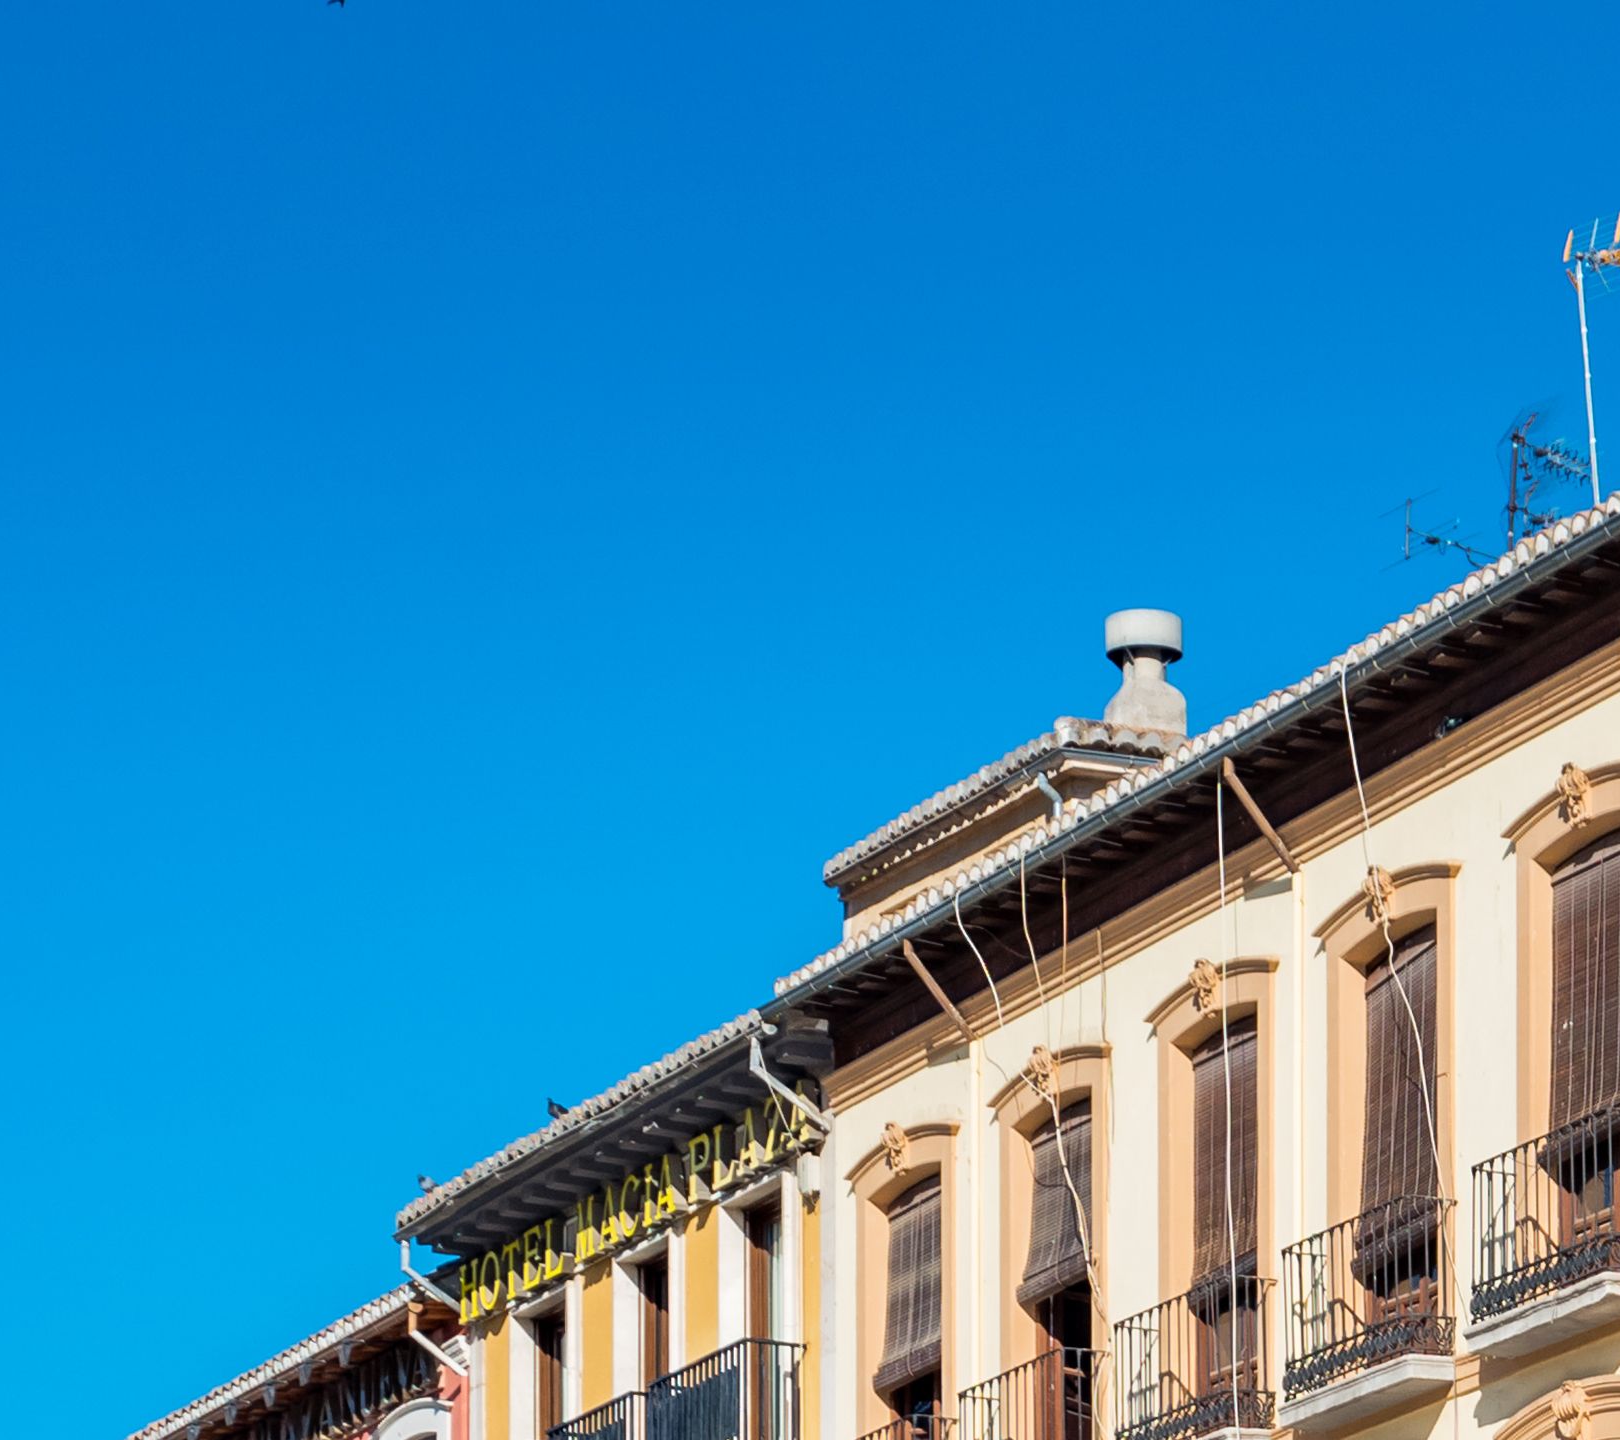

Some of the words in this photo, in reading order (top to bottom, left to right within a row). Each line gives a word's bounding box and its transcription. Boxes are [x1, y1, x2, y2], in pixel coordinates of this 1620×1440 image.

[458, 1217, 564, 1326] HOTEL
[575, 1153, 677, 1264] MACIA
[687, 1080, 812, 1203] PLAZA
